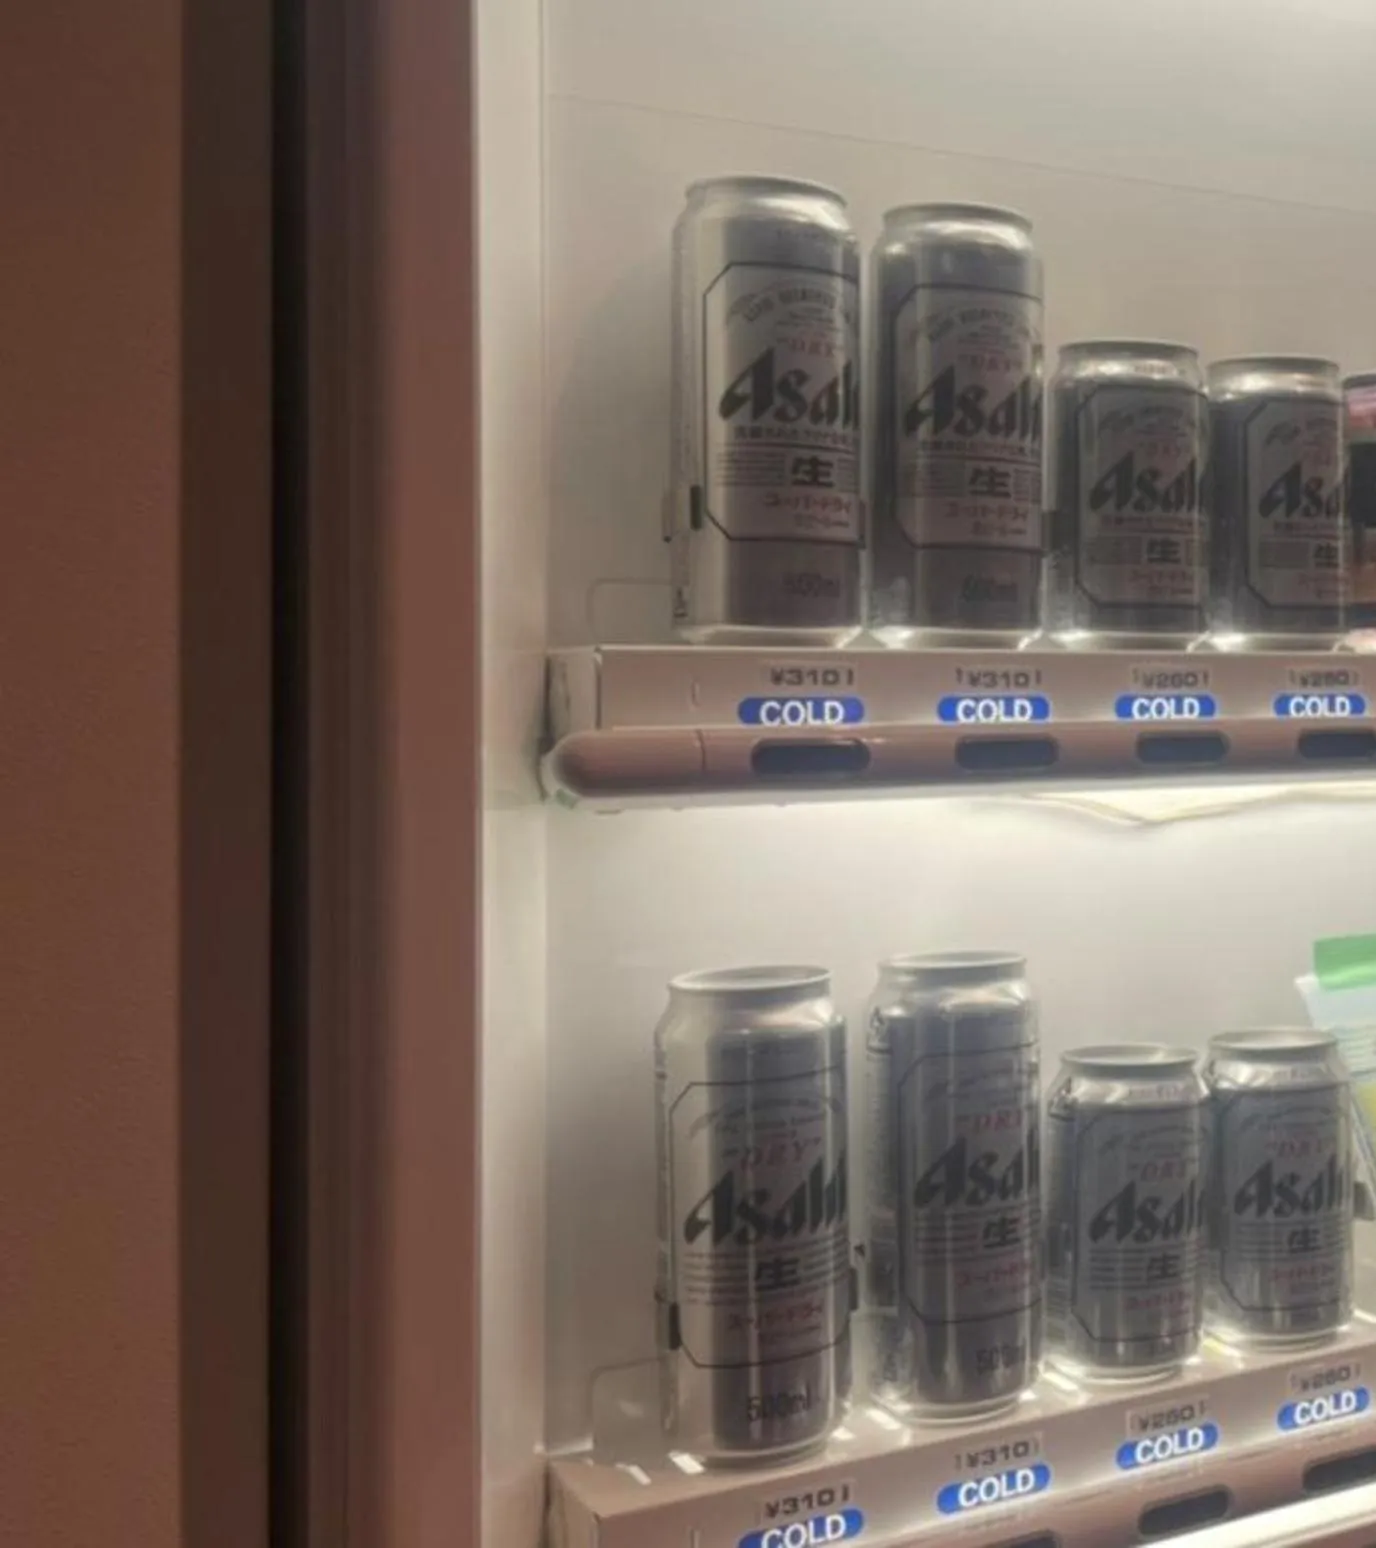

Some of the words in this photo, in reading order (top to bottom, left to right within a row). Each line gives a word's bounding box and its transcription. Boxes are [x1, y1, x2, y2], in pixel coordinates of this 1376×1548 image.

[719, 347, 860, 429] Asah
[904, 364, 1043, 440] Asah
[791, 456, 834, 488] 生
[968, 466, 1012, 498] 生
[759, 700, 845, 727] COLD
[956, 698, 1033, 724] COLD
[1131, 696, 1200, 720] COLD
[1289, 696, 1352, 719] COLD
[914, 1130, 1040, 1208] Asah
[1293, 1389, 1358, 1425] COLD
[1134, 1427, 1206, 1464] COLD
[957, 1468, 1035, 1507] COLD
[760, 1512, 847, 1548] COLD
